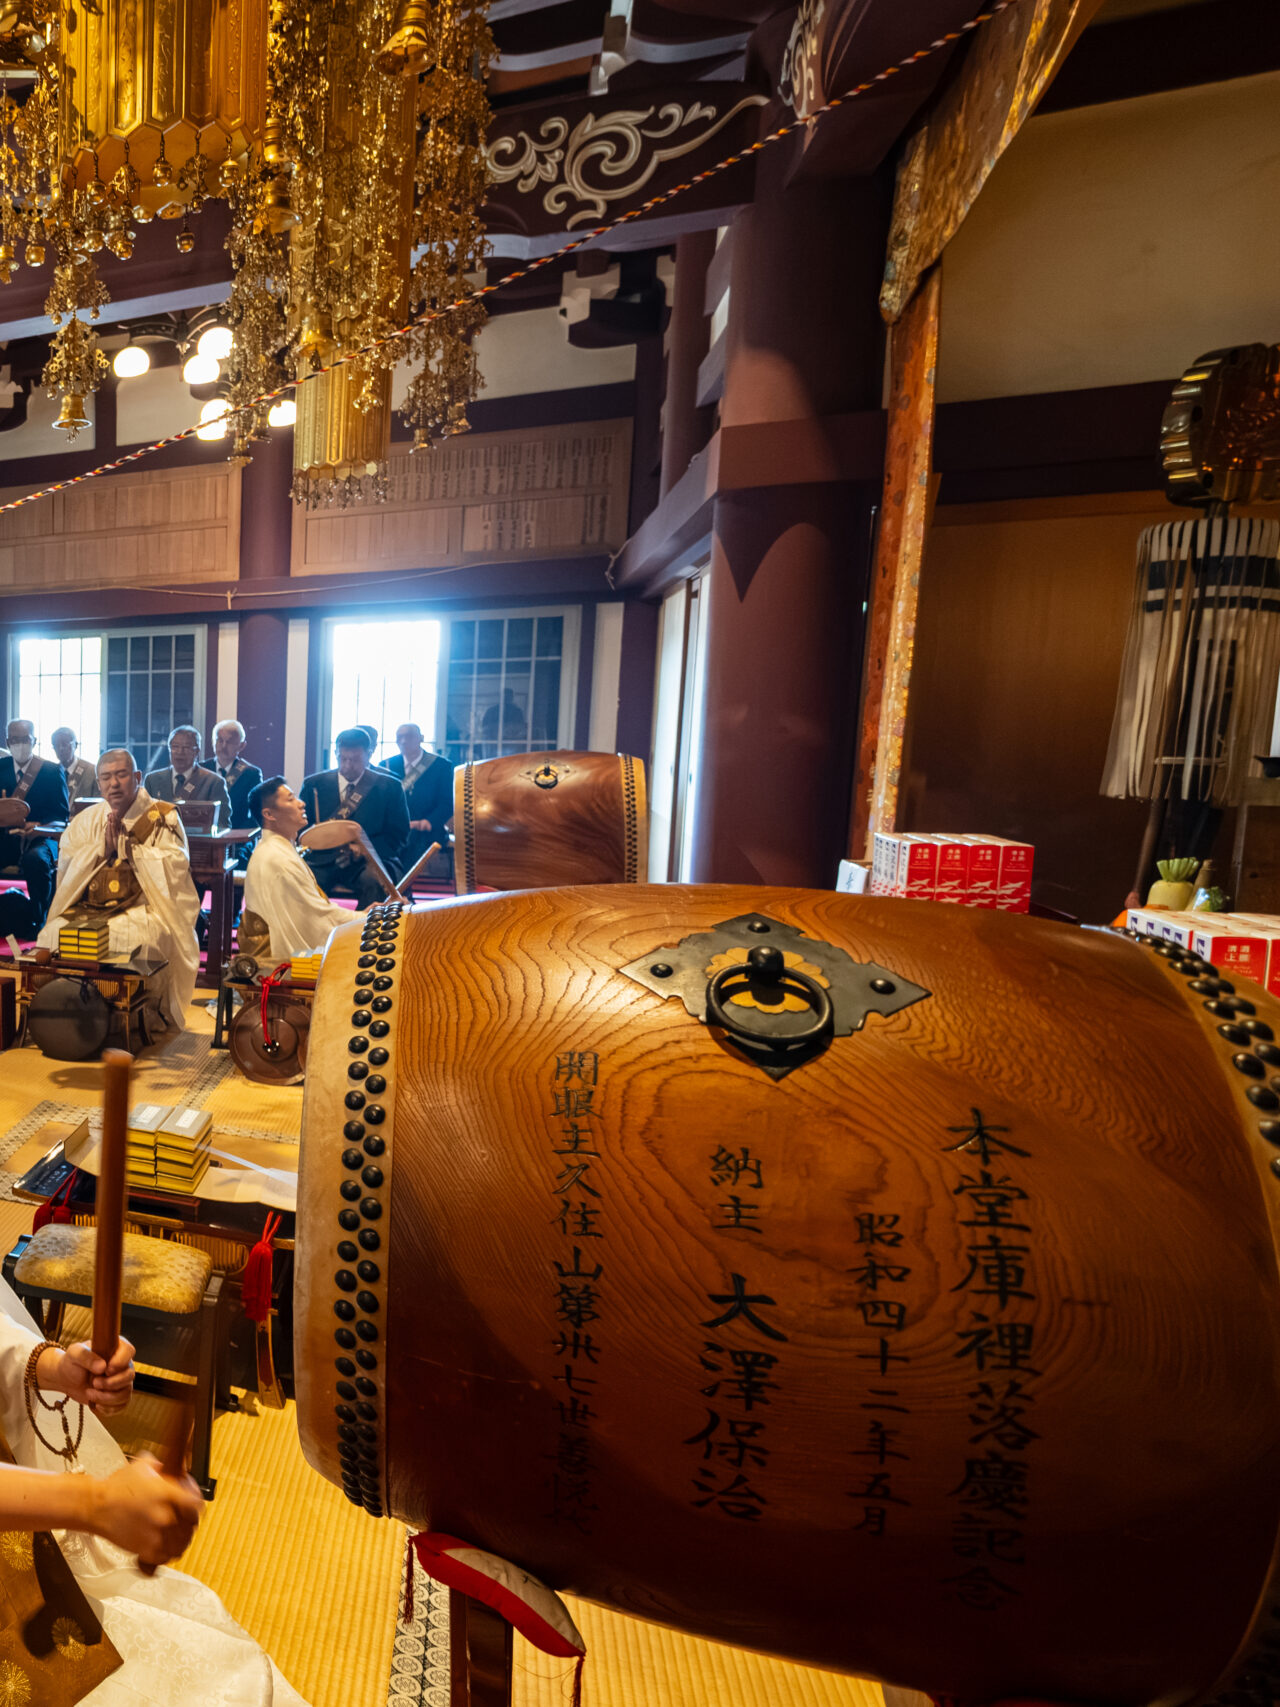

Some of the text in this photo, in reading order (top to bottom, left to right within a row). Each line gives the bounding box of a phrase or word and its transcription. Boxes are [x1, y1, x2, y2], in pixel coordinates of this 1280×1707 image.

[681, 1143, 790, 1522] 納主 大澤保治
[845, 1212, 913, 1536] 昭和四十二年五月
[937, 1106, 1045, 1613] 本堂庫裡落慶記念
